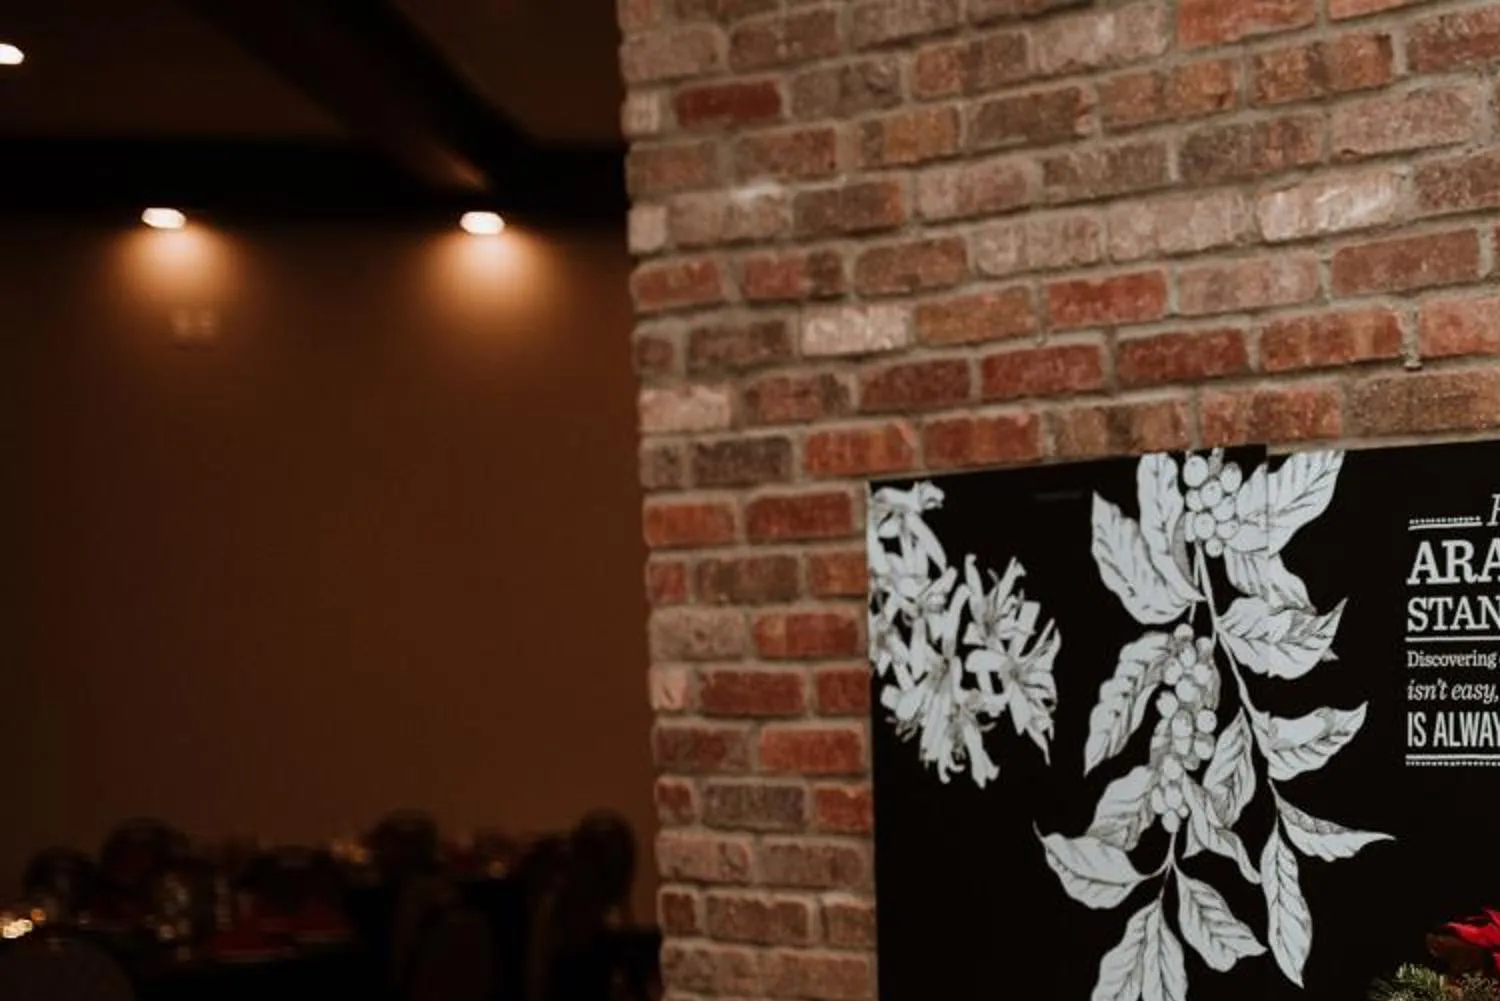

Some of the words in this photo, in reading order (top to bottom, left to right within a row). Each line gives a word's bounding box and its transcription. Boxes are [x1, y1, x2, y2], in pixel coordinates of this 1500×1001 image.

[1407, 650, 1497, 668] Discovering
[1407, 678, 1448, 701] isn't
[1451, 682, 1499, 704] easy,
[1407, 711, 1427, 748] IS
